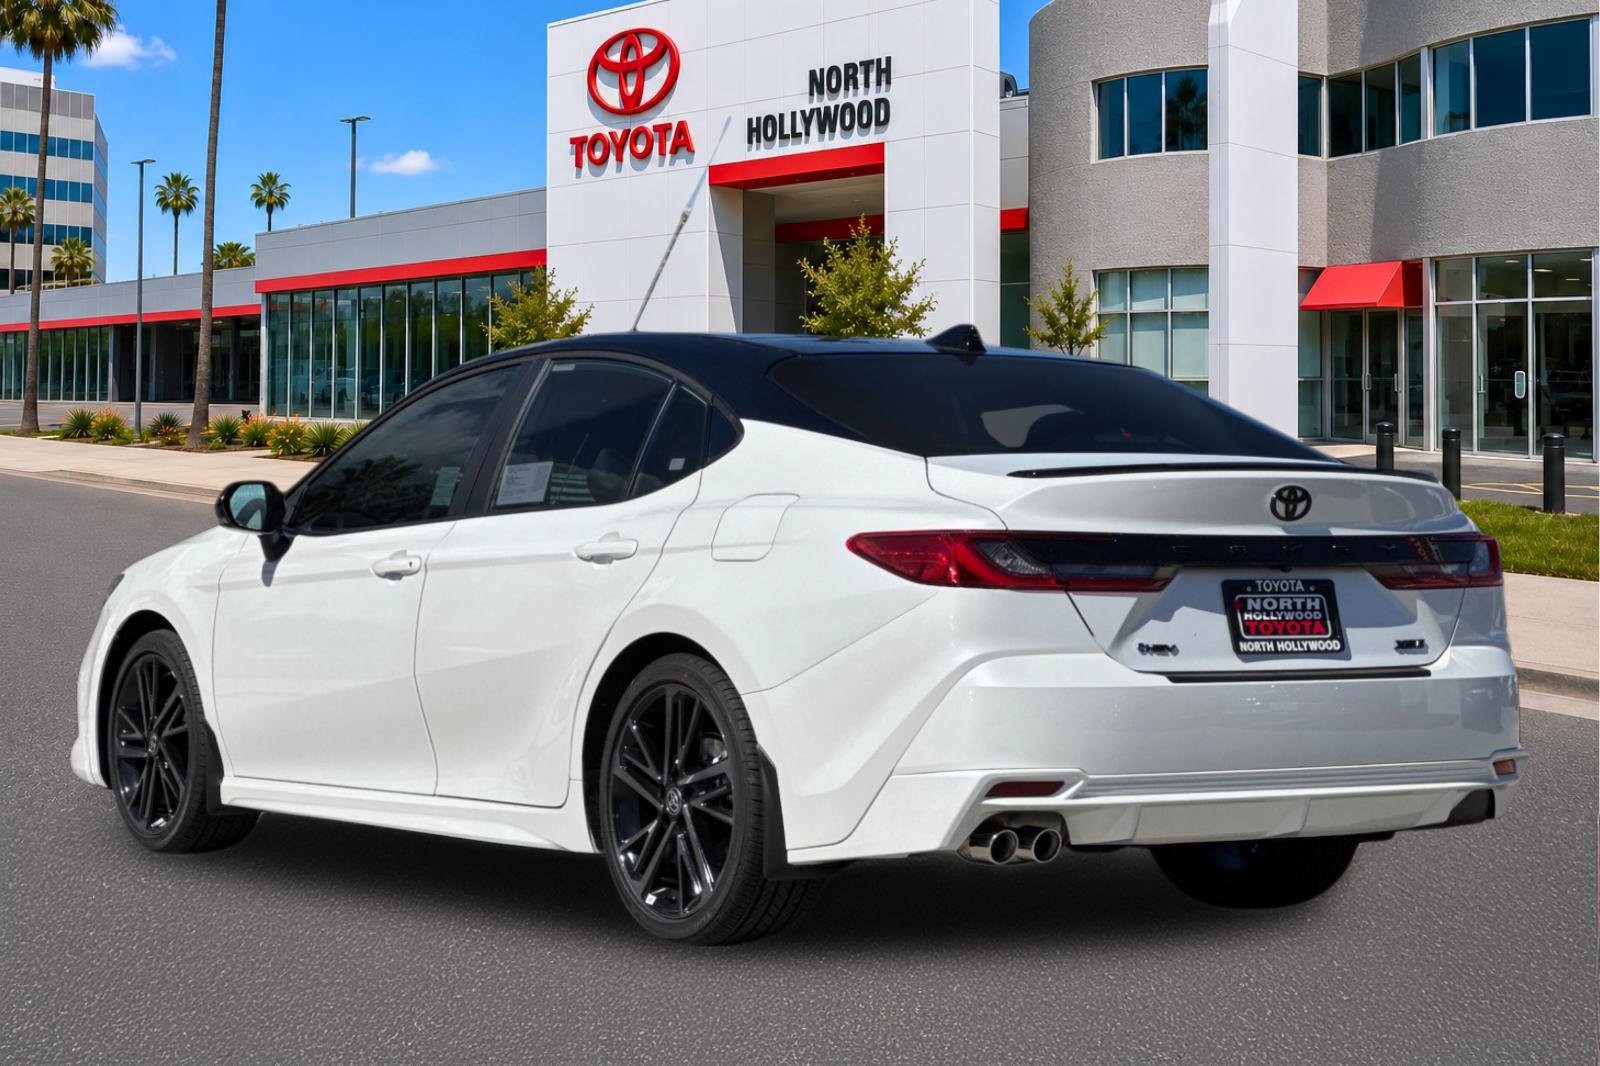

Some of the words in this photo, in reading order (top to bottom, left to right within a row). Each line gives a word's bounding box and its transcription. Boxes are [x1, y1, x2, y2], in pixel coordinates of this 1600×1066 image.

[808, 56, 892, 97] NORTH
[747, 97, 890, 145] HOLLYWOOD
[570, 120, 695, 169] TOYOTA
[1255, 580, 1305, 592] TOYOTA
[1247, 598, 1320, 610] NORTH
[1244, 611, 1322, 620] HOLLYWOOD
[1245, 621, 1326, 635] TOYOTA
[1240, 641, 1274, 652] NORTH
[1277, 639, 1341, 652] HOLLYWOOD
